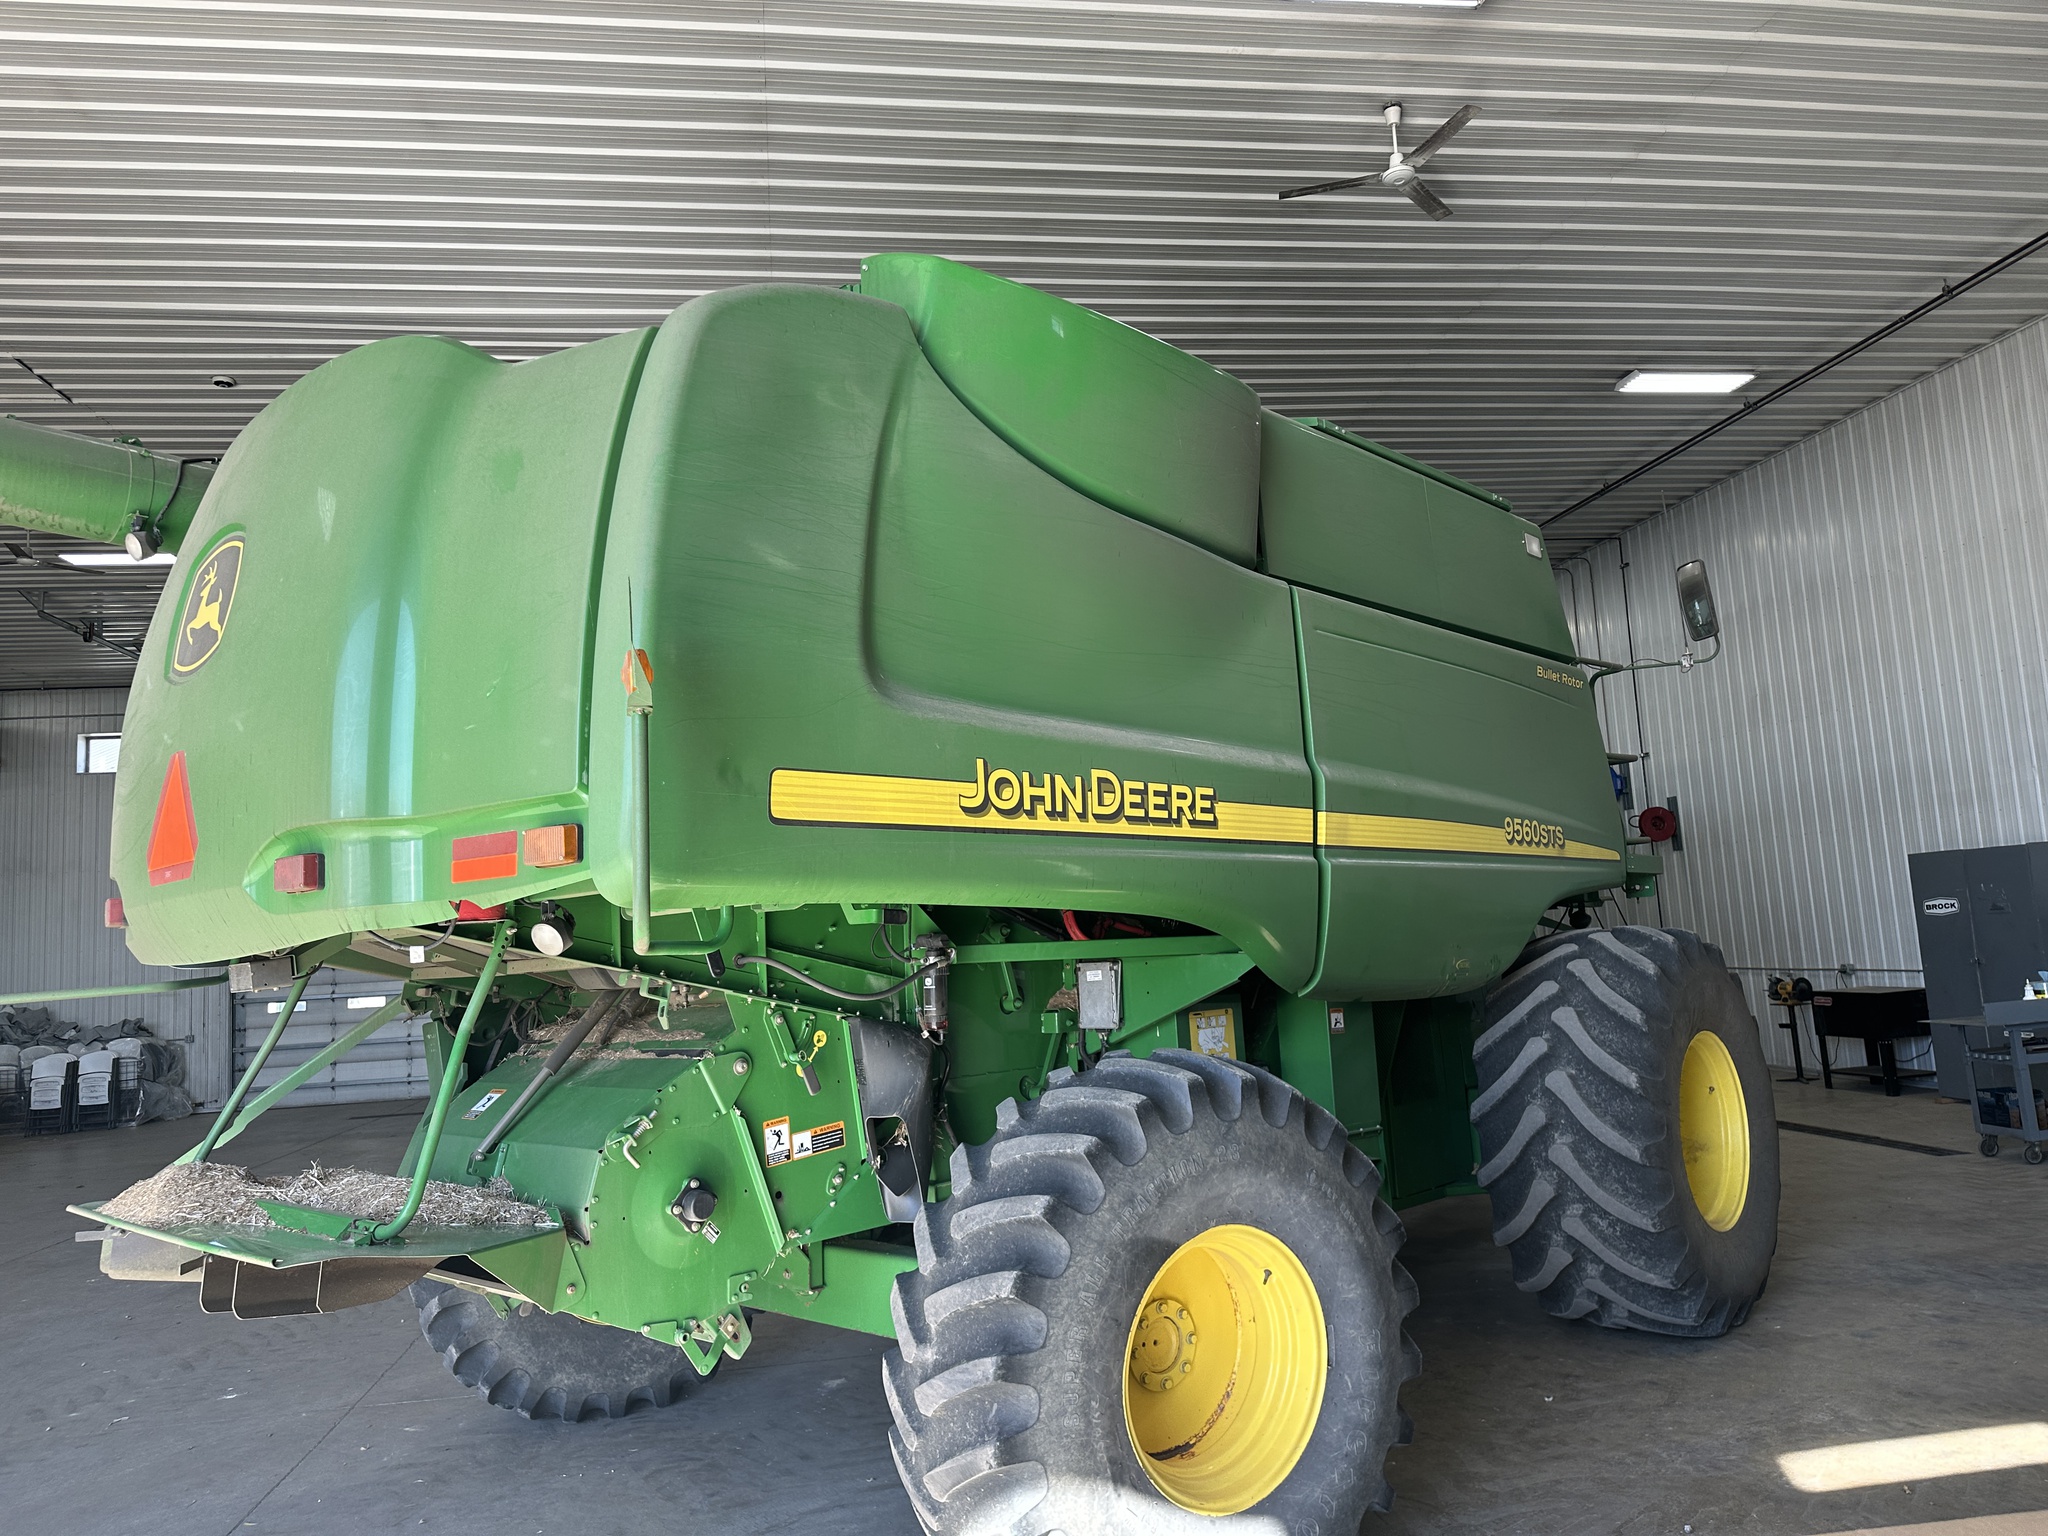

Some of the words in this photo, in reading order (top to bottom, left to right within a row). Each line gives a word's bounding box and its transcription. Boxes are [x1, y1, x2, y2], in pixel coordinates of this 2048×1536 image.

[1536, 665, 1561, 683] Bullet
[1561, 672, 1584, 689] Rotor
[958, 757, 1087, 822] JOHN
[1090, 768, 1219, 829] DEERE
[1504, 816, 1565, 848] 9560STS
[1925, 902, 1956, 910] BROCK
[819, 1124, 840, 1132] WARNING
[1062, 1326, 1088, 1428] SUPER
[1080, 1254, 1112, 1307] ALL
[1111, 1152, 1205, 1241] TRACTION
